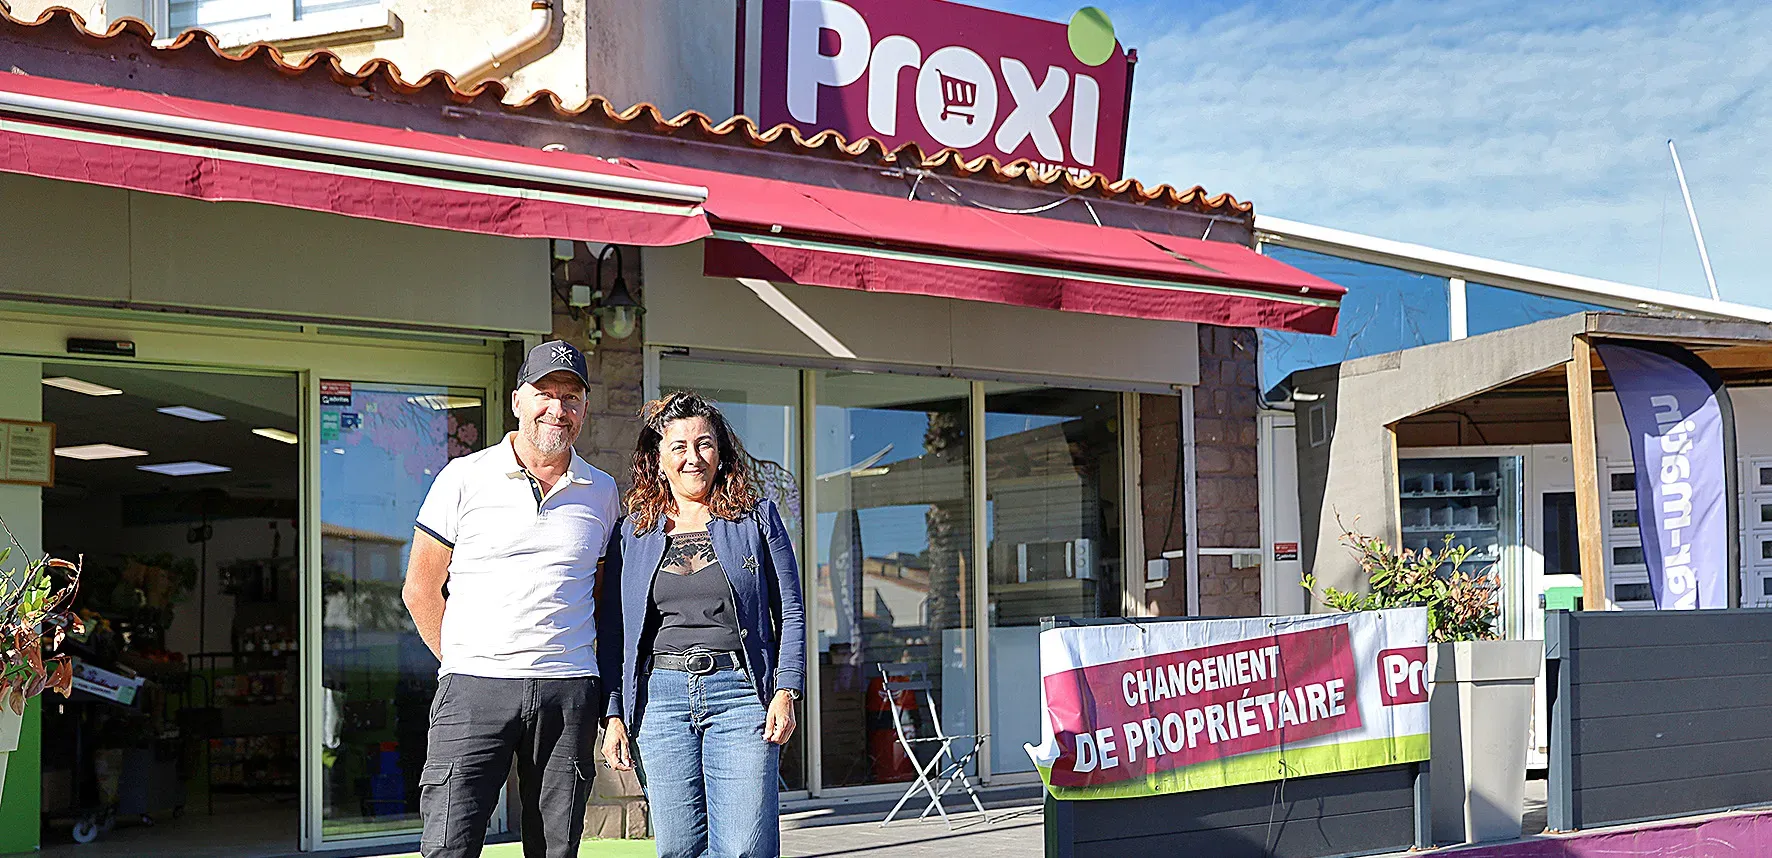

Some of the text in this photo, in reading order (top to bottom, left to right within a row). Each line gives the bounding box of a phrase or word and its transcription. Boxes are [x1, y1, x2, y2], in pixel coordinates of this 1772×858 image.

[787, 0, 1116, 167] Proxi
[1121, 645, 1280, 707] CHANGEMENT
[1072, 678, 1346, 773] DE PROPRIÉTAIRE
